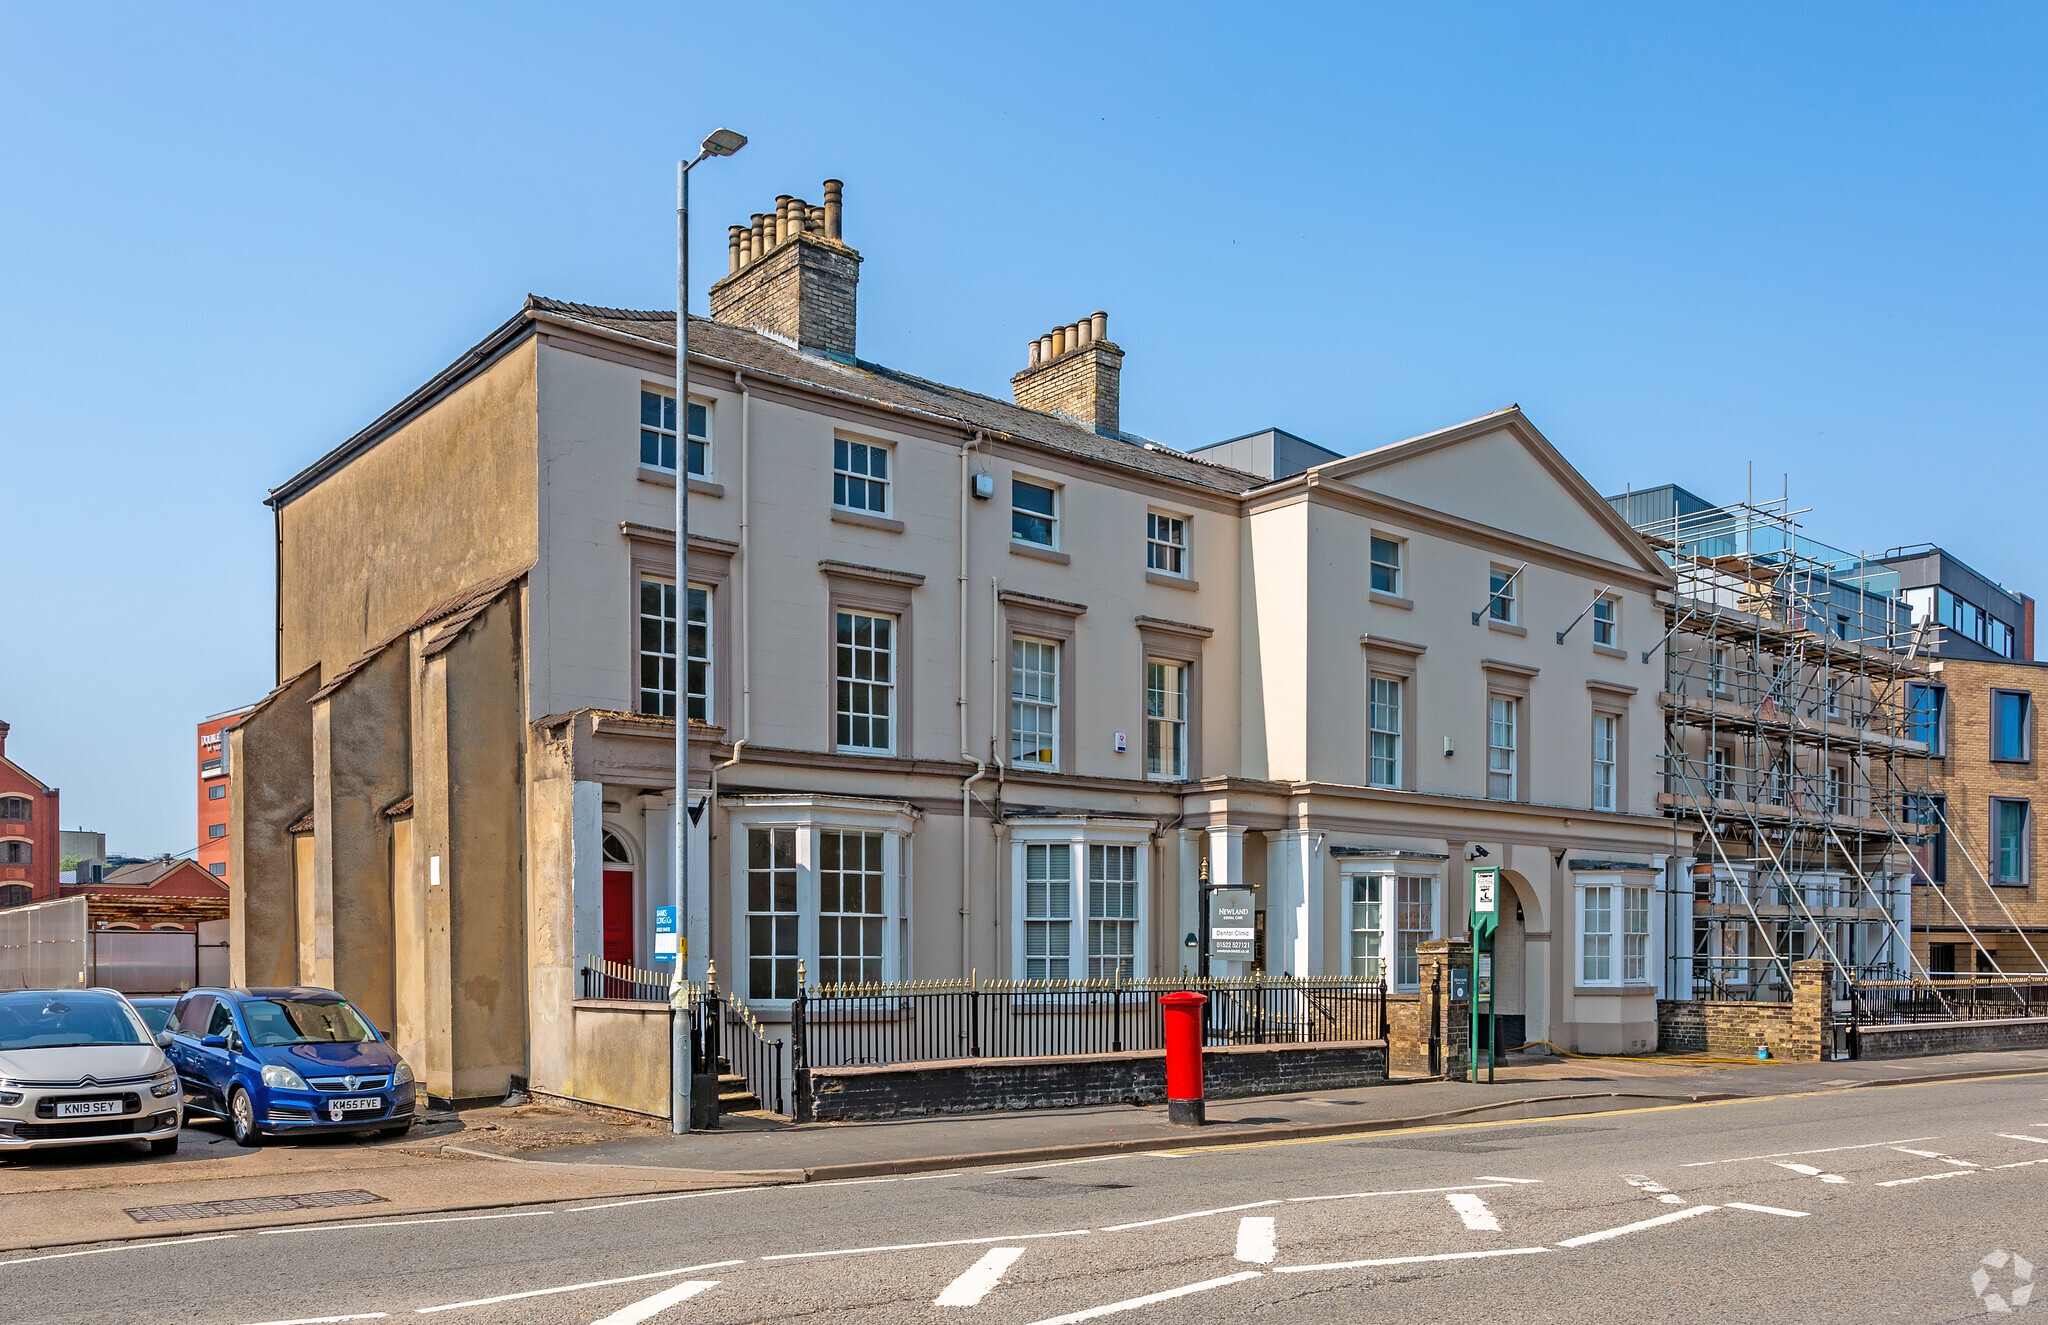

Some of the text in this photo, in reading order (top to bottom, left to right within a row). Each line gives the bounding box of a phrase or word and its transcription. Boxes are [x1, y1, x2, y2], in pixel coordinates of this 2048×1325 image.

[1218, 908, 1249, 916] NEWLAND
[1216, 941, 1250, 949] 01522 527121
[64, 1102, 115, 1114] KN19 SEY
[332, 1099, 378, 1110] KM55 FVE
